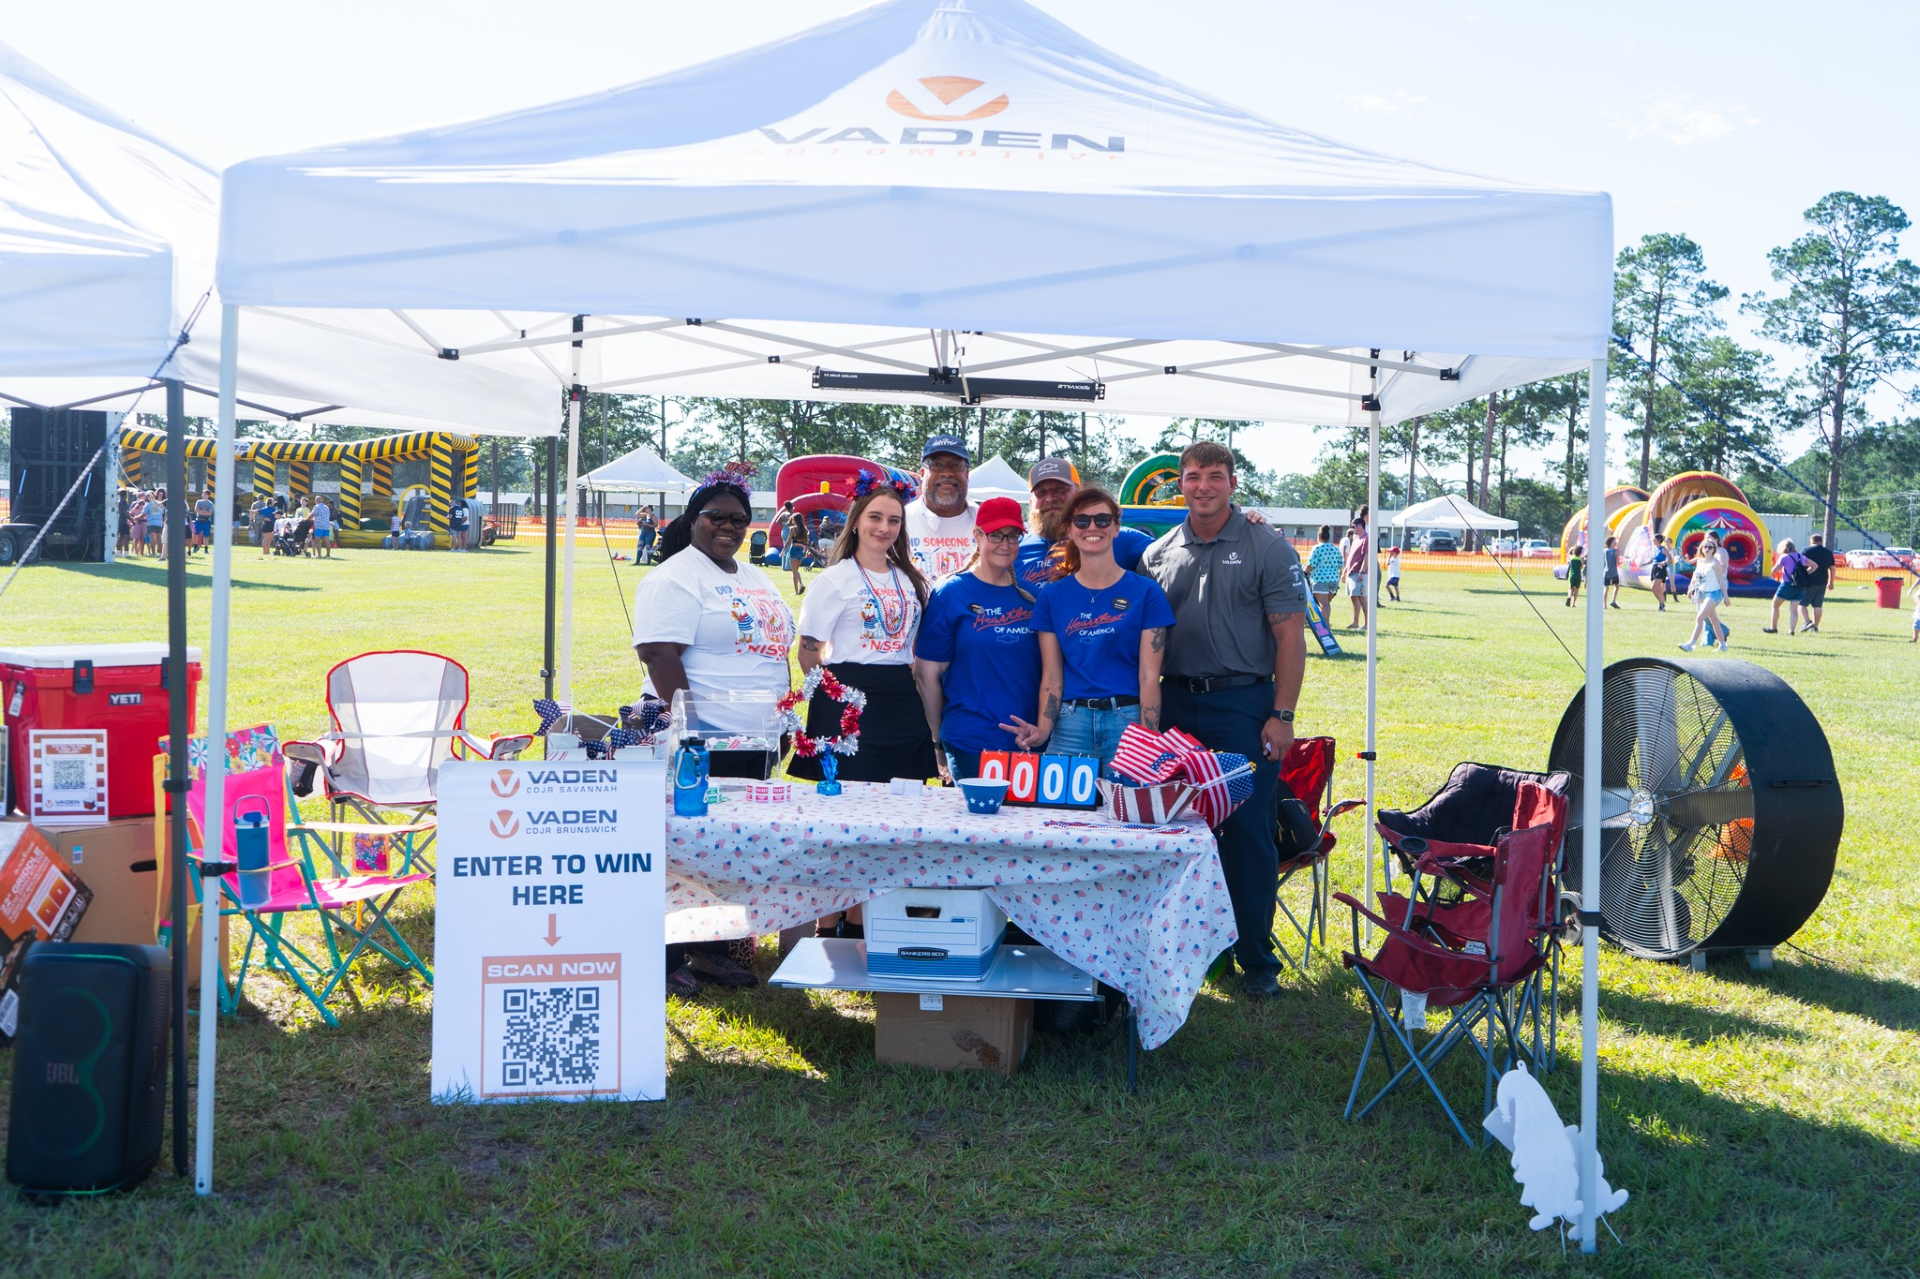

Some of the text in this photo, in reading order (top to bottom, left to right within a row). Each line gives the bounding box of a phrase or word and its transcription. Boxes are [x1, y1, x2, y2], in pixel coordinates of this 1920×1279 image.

[758, 126, 1125, 152] VADEN
[923, 537, 970, 547] SOMEONE
[715, 585, 733, 596] DID
[985, 607, 1003, 616] THE
[1087, 627, 1115, 637] AMERICA
[110, 694, 141, 705] YETI
[527, 769, 617, 784] VADEN
[526, 785, 617, 794] CDJR SAVANNAH
[526, 809, 617, 825] VADEN
[526, 825, 617, 835] CDJR BRUNSWICK
[12, 845, 43, 894] GRIDDLE
[453, 853, 652, 877] ENTER TO WIN
[512, 884, 583, 906] HERE
[487, 961, 616, 978] SCAN NOW
[46, 1062, 79, 1084] JBL
